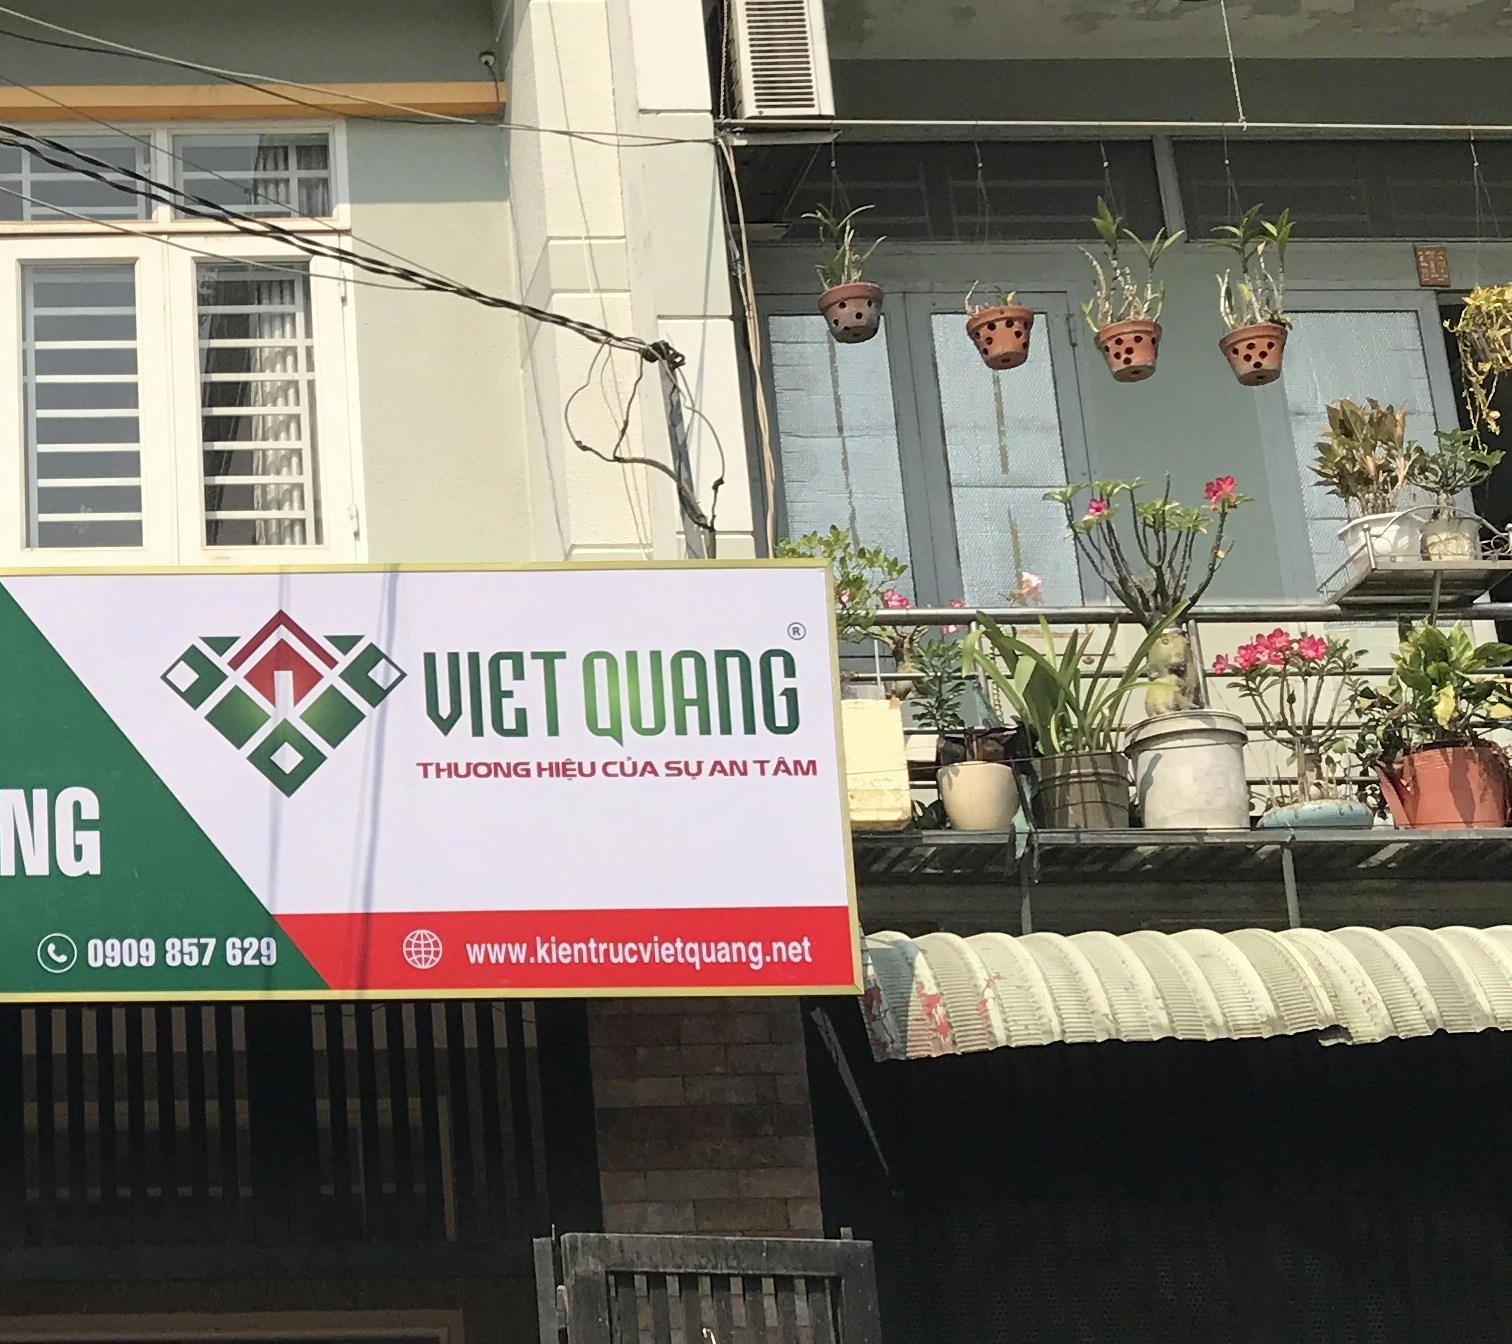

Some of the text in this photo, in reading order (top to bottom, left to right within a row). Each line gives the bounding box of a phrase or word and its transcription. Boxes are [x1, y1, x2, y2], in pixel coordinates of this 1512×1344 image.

[423, 648, 801, 747] VIET QUANG
[416, 756, 818, 781] THƯƠNG HIỆU CỦA SỰ AN TÂM
[87, 936, 277, 968] 0909 857 629
[465, 935, 813, 971] www.kientrucvietquang.net
